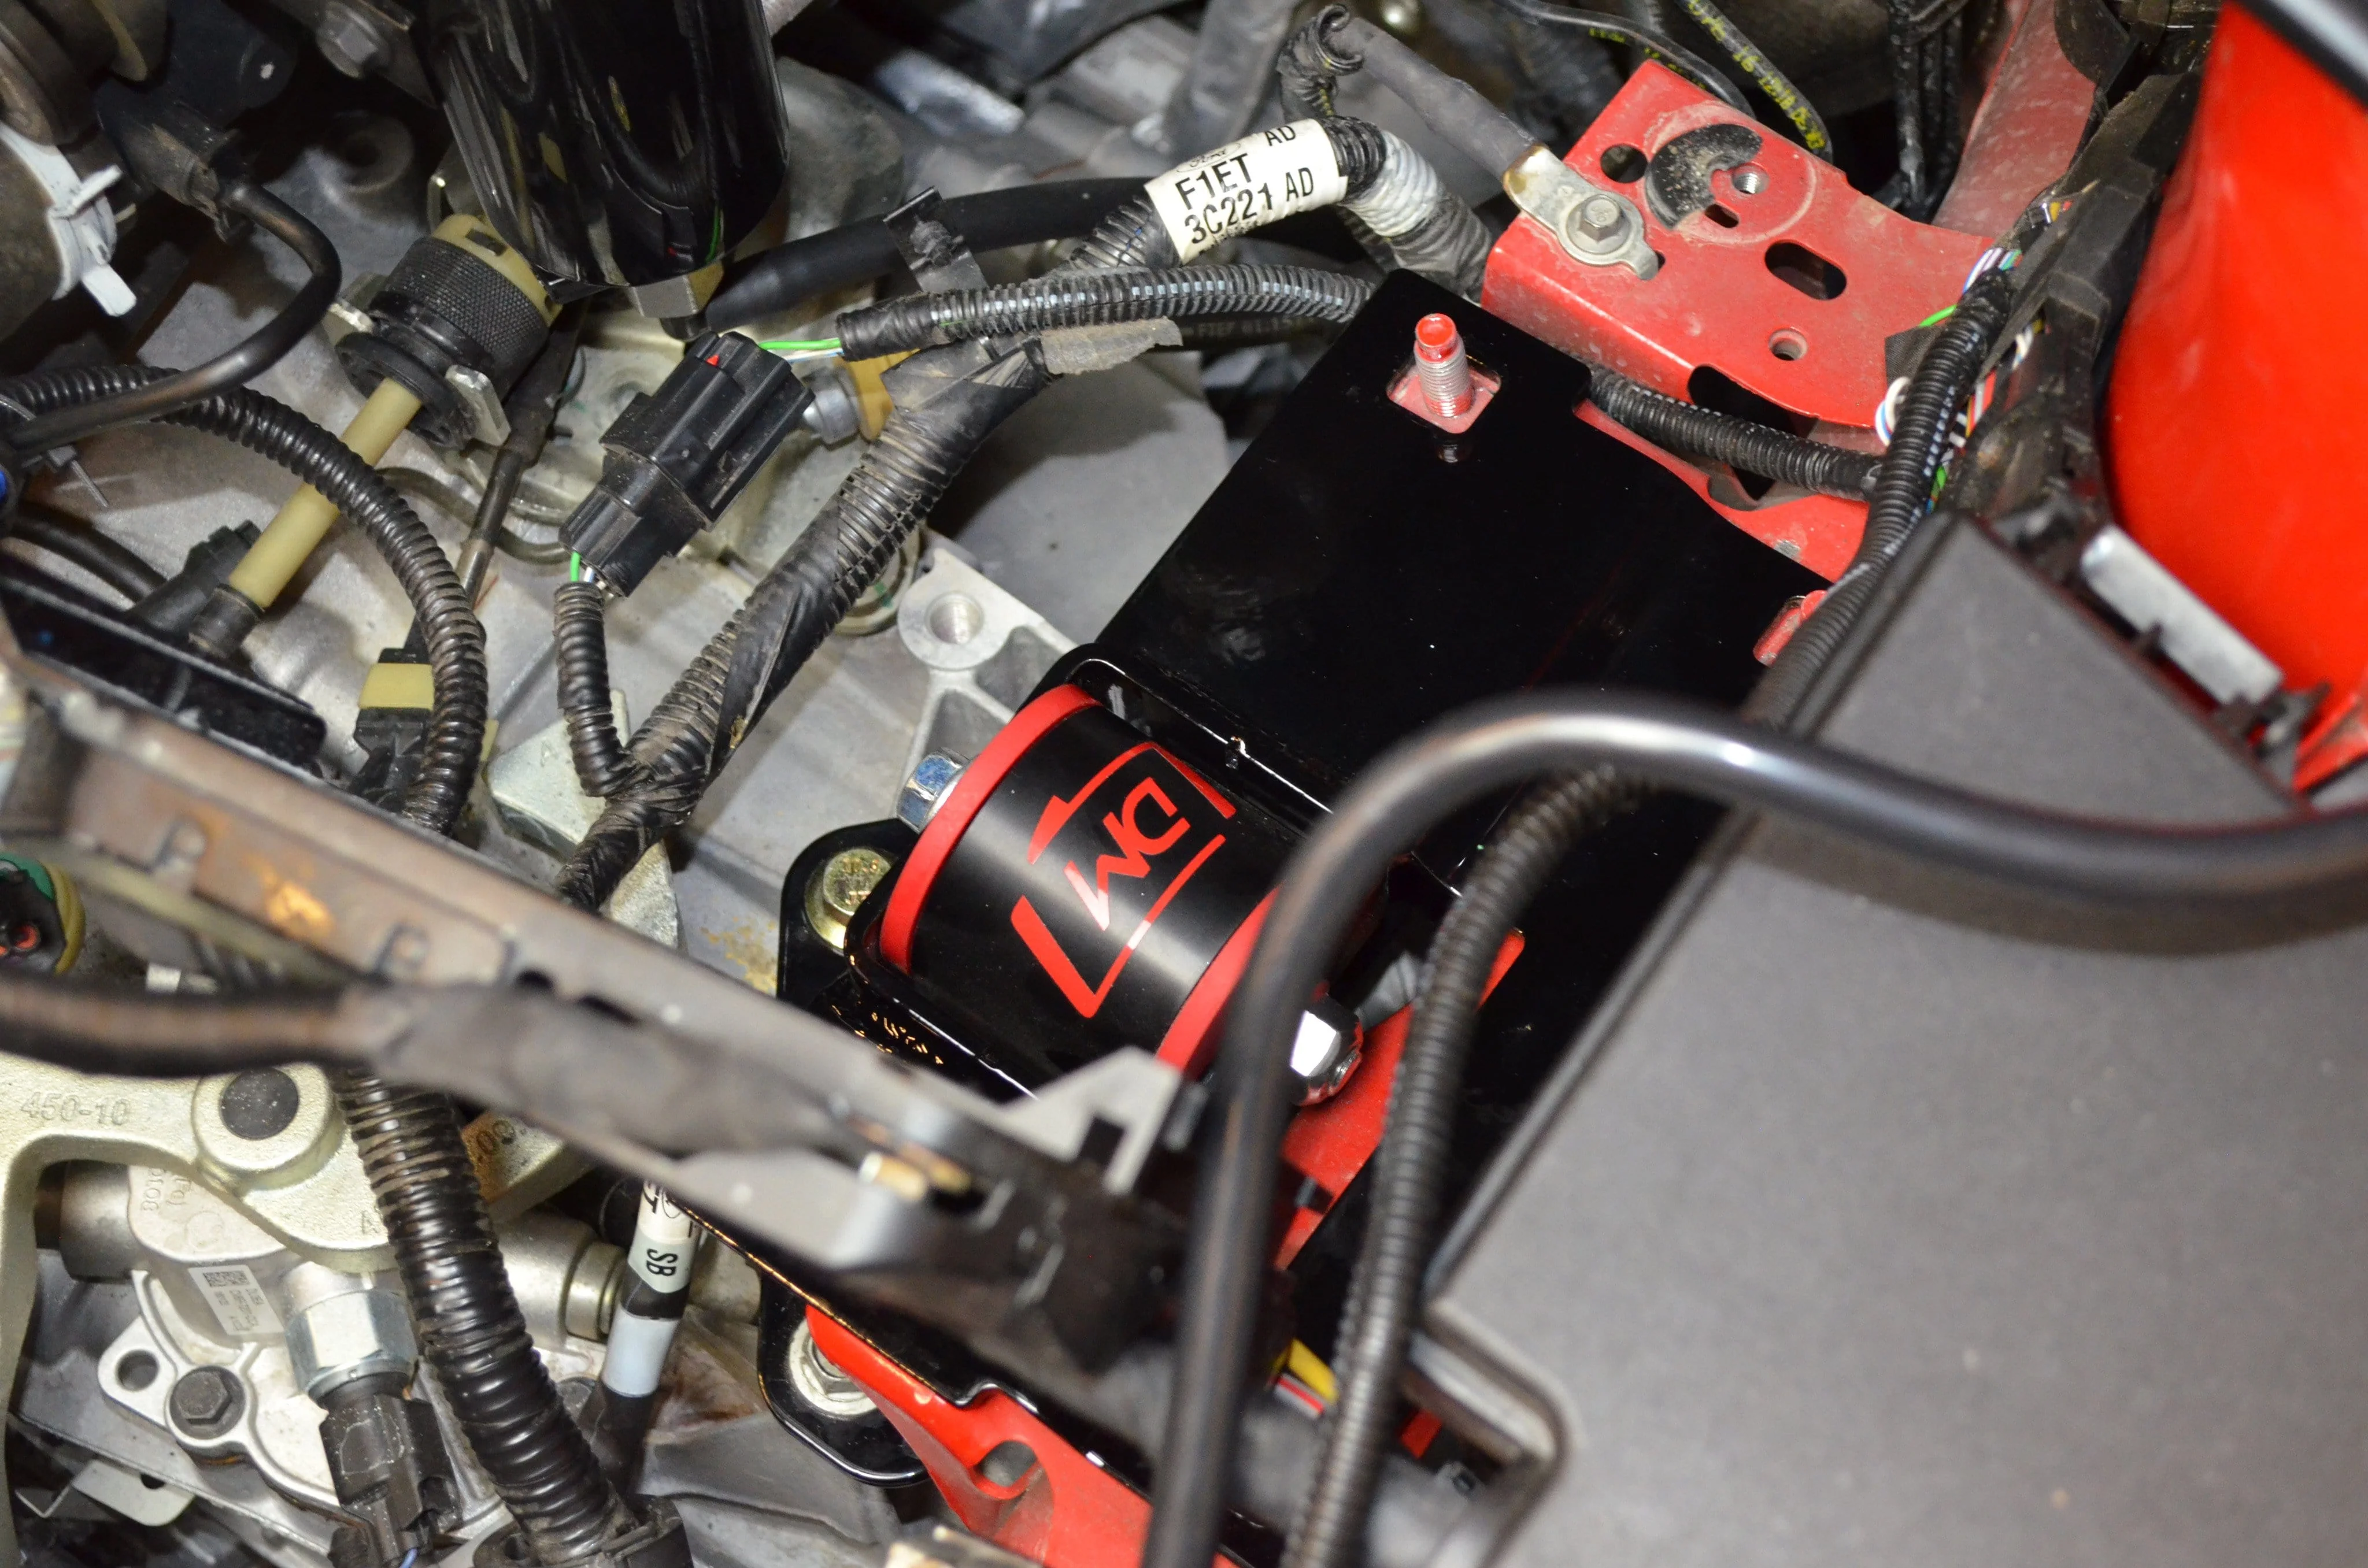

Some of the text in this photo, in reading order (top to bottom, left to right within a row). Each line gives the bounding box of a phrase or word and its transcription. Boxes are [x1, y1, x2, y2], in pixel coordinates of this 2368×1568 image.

[1264, 125, 1296, 146] AD
[1175, 153, 1252, 210] F1ET
[1184, 182, 1273, 244] 3C221
[1285, 167, 1314, 202] AD
[646, 1248, 679, 1277] SB
